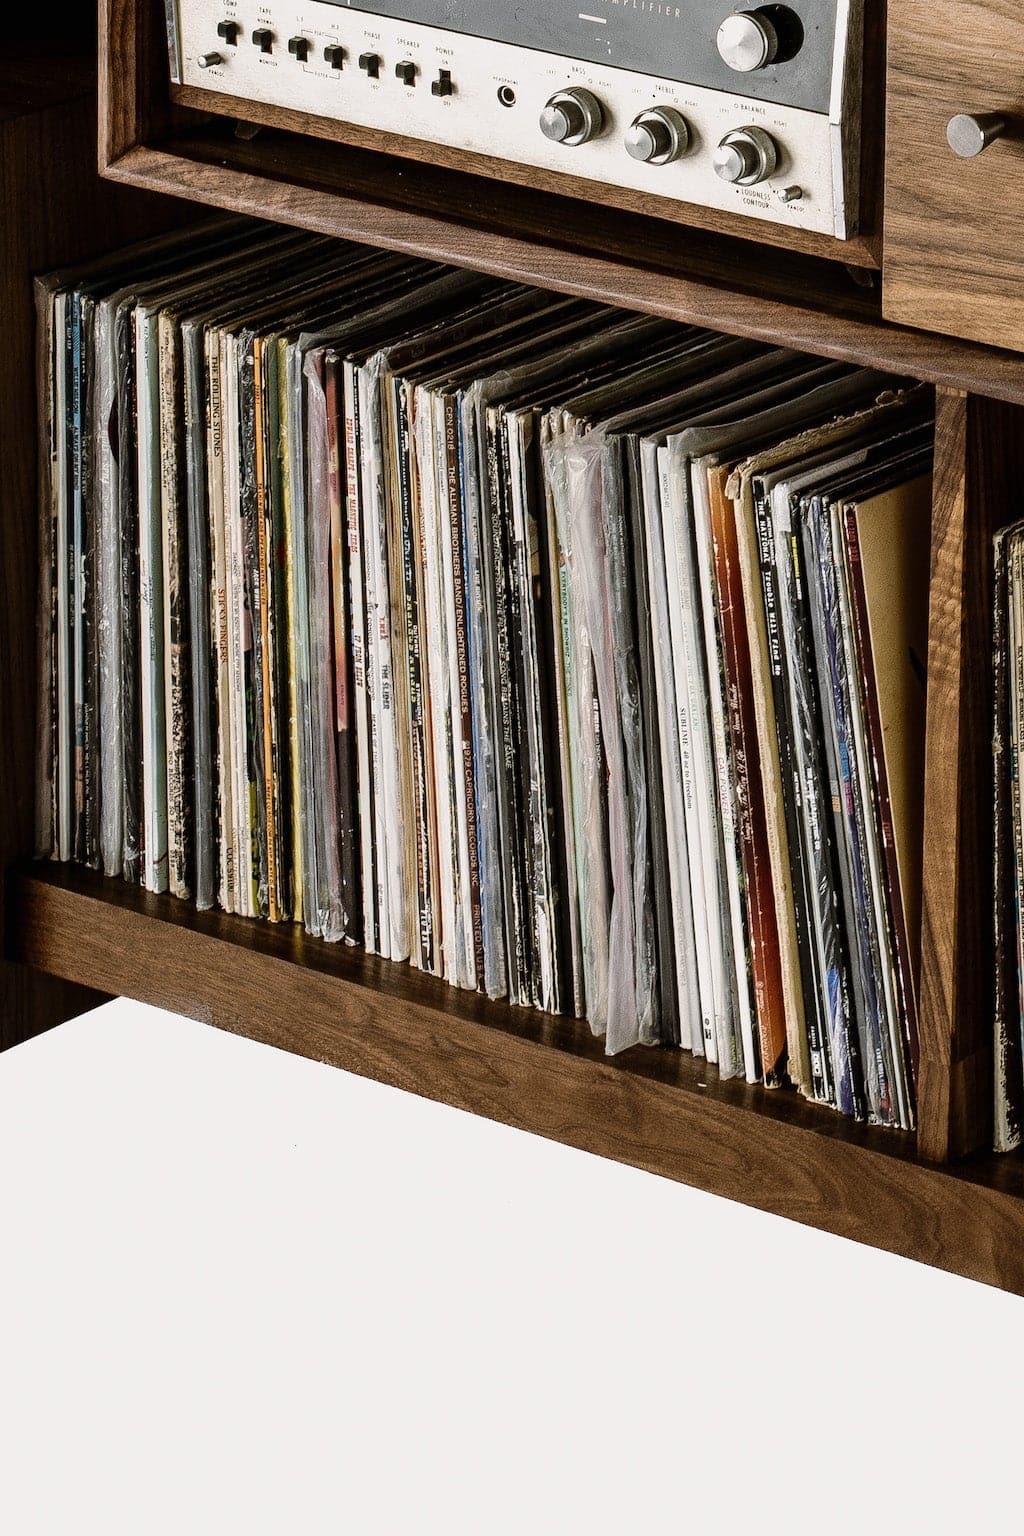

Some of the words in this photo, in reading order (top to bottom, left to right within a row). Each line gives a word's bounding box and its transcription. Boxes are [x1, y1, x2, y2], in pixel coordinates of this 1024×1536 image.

[259, 7, 272, 16] TAPE
[364, 30, 381, 40] PHASE
[396, 37, 420, 48] SPEAKER
[435, 46, 454, 56] POWER
[571, 66, 586, 76] BASS
[740, 104, 766, 115] BALANCE
[741, 188, 771, 200] LOUDNESS
[742, 198, 770, 210] CONTOUR
[210, 355, 219, 374] THE
[211, 377, 221, 418] ROLLING
[445, 406, 455, 426] CPN
[212, 421, 222, 458] STONES
[447, 465, 458, 485] THE
[448, 486, 460, 523] ALLMAN
[450, 526, 462, 576] BROTHERS
[759, 520, 771, 564] NATIONAL
[494, 574, 503, 597] FROM
[764, 570, 775, 608] Trouble
[217, 587, 227, 620] STICKY
[253, 587, 261, 610] WHITE
[768, 612, 778, 634] Will
[218, 624, 229, 664] FINGERS
[770, 638, 781, 661] Find
[380, 664, 390, 680] THE
[499, 660, 508, 684] SONG
[381, 681, 391, 710] SLIDER
[458, 675, 470, 714] ROGUES
[679, 707, 690, 746] SUBLIME
[503, 744, 513, 769] SAME
[464, 770, 476, 823] CAPRICORN
[684, 779, 694, 810] freedom
[467, 825, 479, 868] RECORDS
[472, 904, 483, 942] PRINTED
